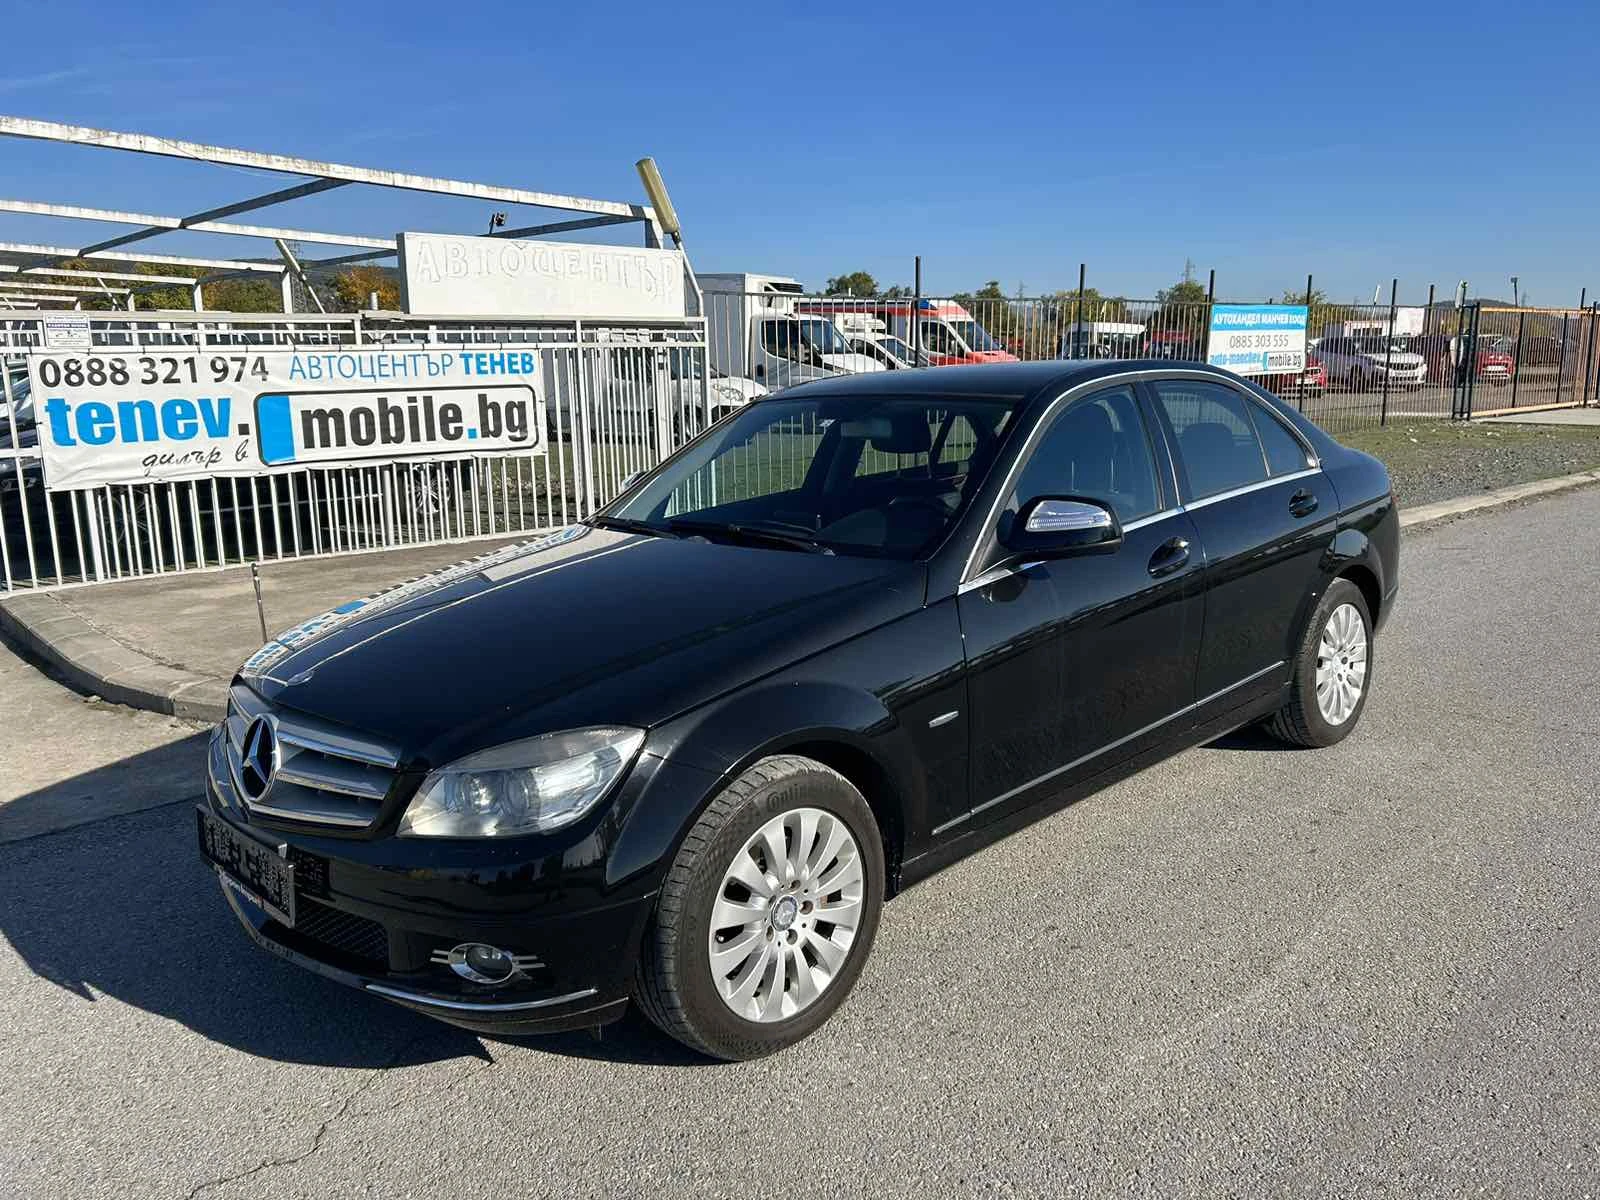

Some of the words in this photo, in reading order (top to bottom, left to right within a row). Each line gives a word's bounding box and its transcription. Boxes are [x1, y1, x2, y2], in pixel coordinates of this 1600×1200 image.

[415, 239, 683, 303] АВТОЦЕНТЪР
[1229, 335, 1252, 348] 0885
[1254, 335, 1271, 347] 303
[1273, 334, 1289, 347] 555
[39, 357, 130, 387] 0888
[138, 357, 198, 384] 321
[210, 356, 269, 382] 974
[289, 353, 453, 383] АВТОЦЕНТЪР
[459, 352, 535, 375] ТЕНЕВ
[1268, 353, 1301, 367] mobile.bg
[301, 394, 528, 449] mobile.bg
[142, 447, 223, 476] дилър
[235, 438, 249, 462] в
